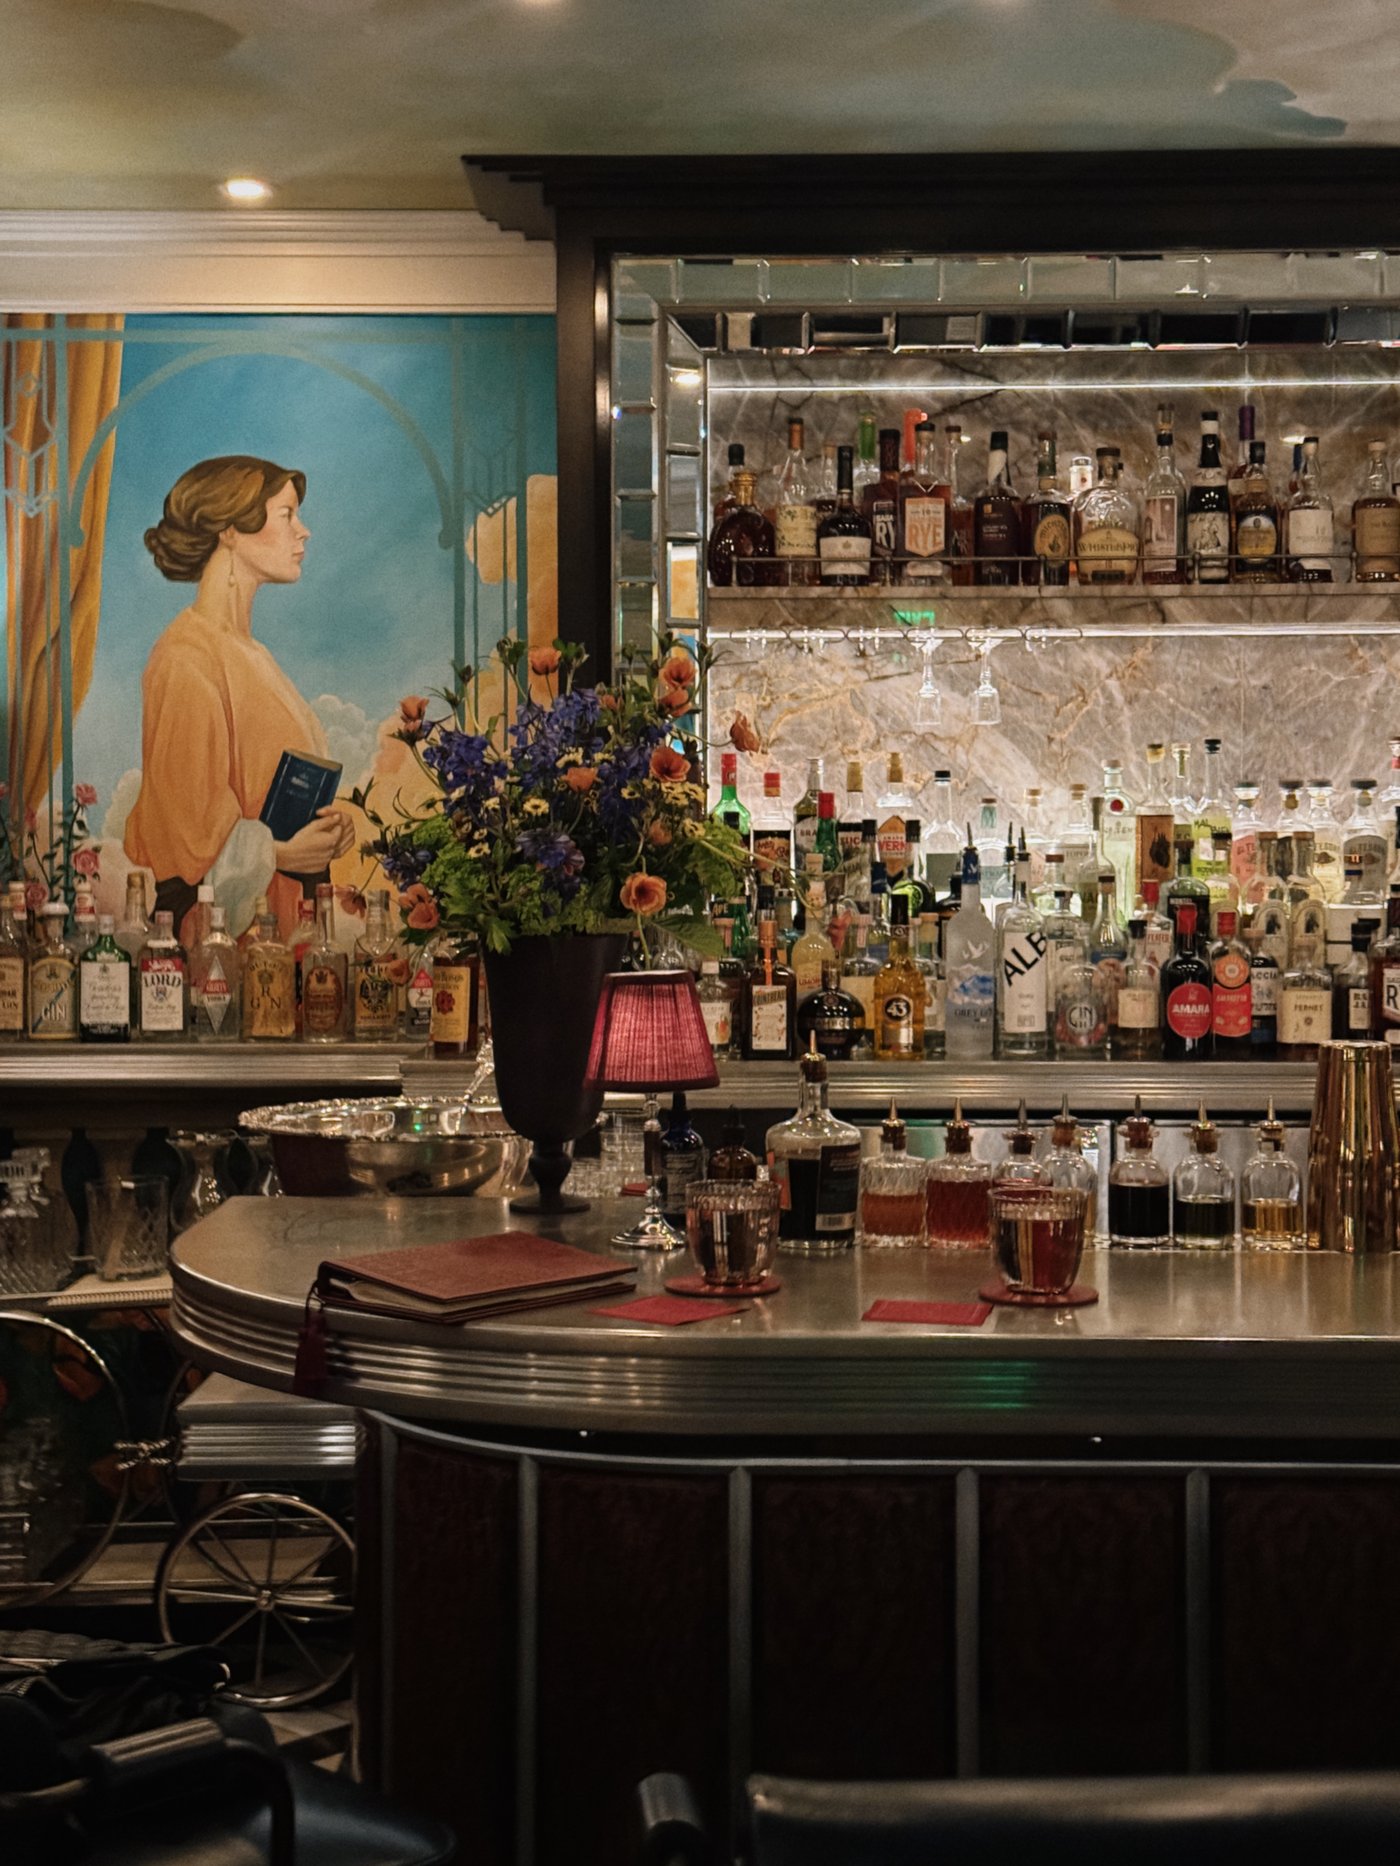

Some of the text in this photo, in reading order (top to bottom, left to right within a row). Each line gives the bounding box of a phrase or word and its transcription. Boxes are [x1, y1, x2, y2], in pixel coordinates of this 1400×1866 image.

[908, 523, 942, 547] RYE
[143, 973, 182, 988] LORD
[1386, 984, 1400, 1011] R
[41, 1002, 67, 1020] GIN
[886, 1001, 908, 1017] 43
